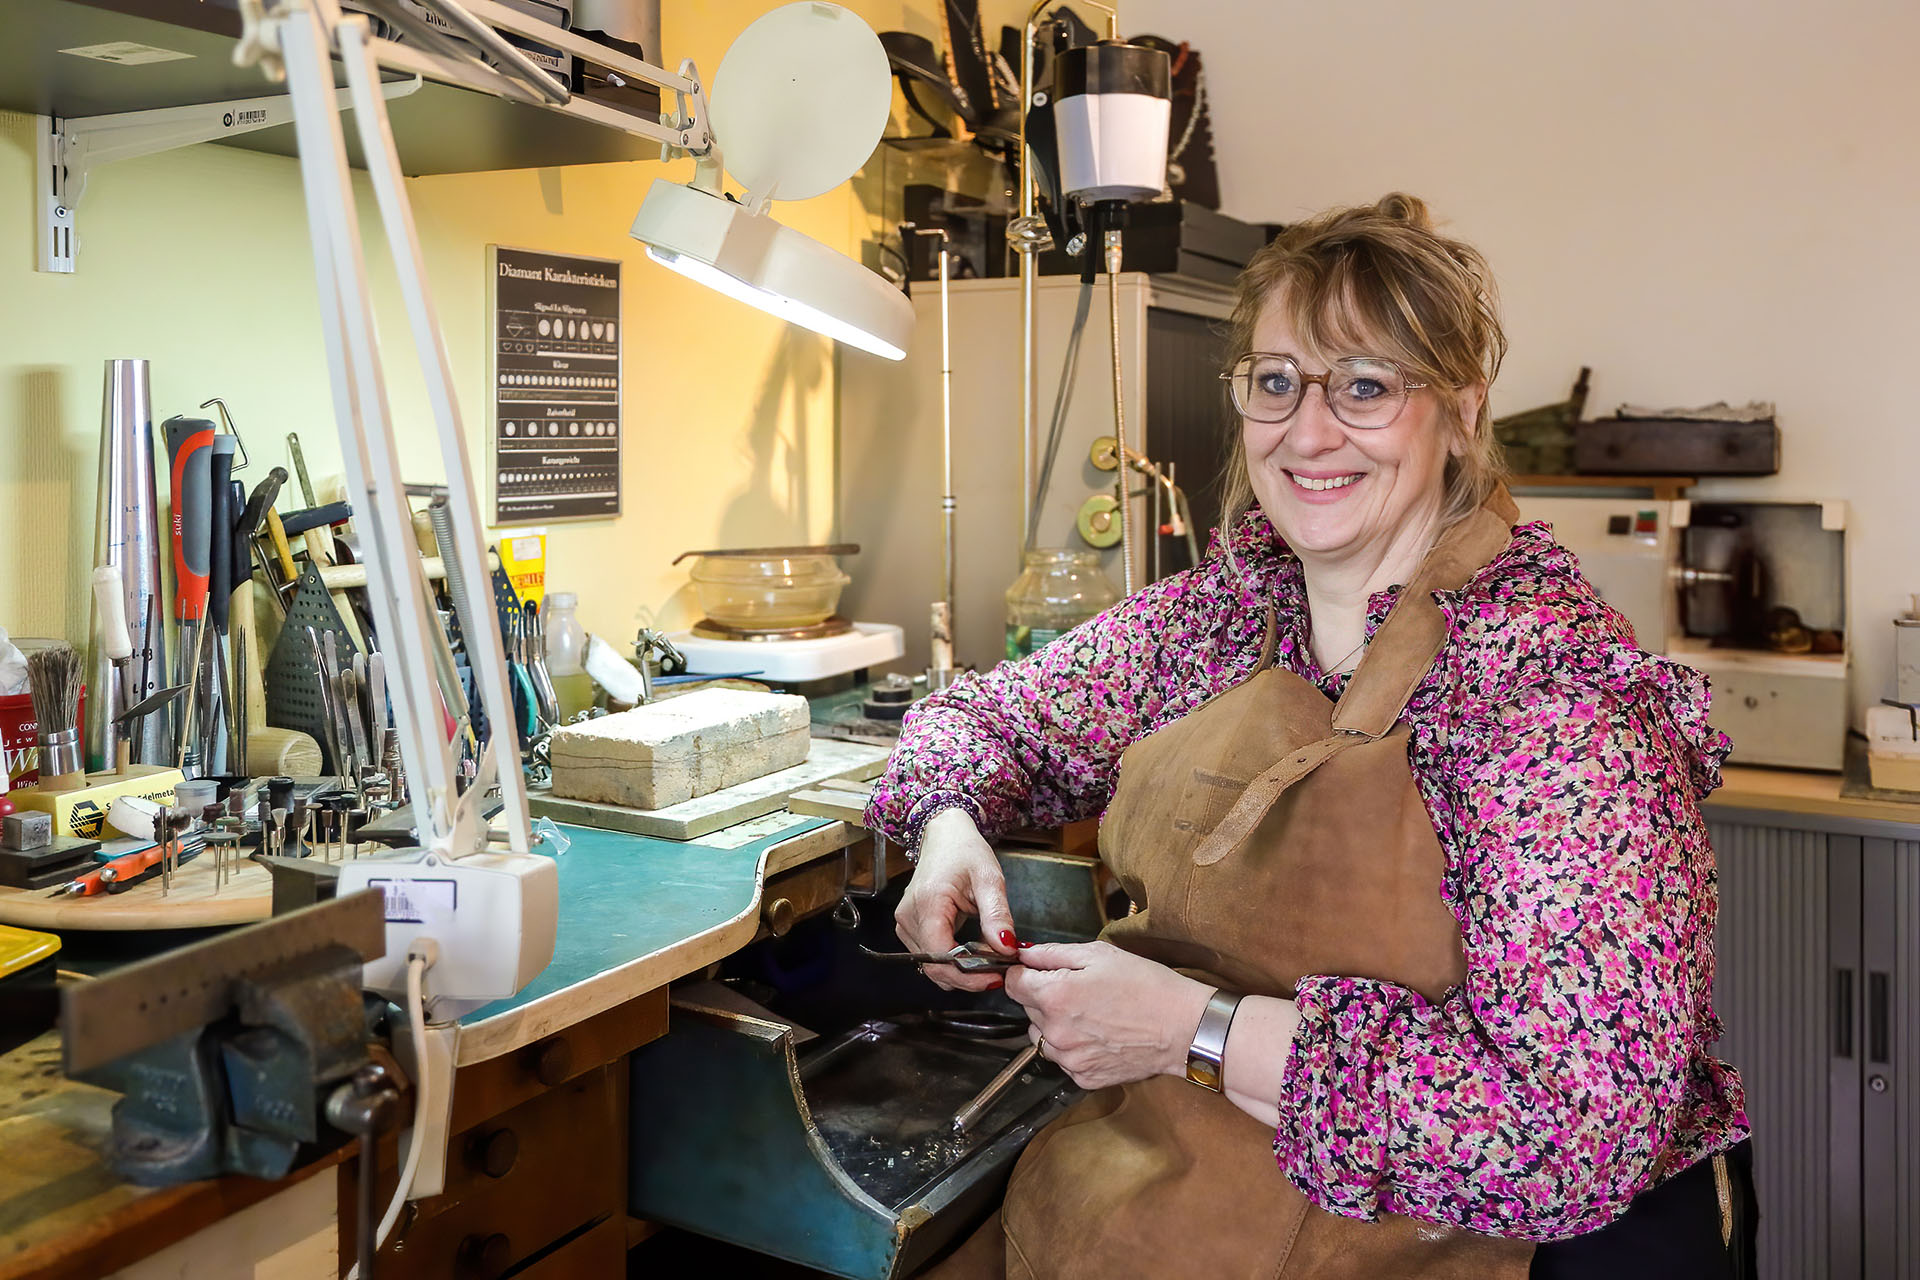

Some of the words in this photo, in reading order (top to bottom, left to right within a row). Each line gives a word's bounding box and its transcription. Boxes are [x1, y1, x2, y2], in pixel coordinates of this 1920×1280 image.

[499, 262, 542, 280] Diamant
[174, 513, 182, 536] suki
[137, 789, 175, 801] delmeta
